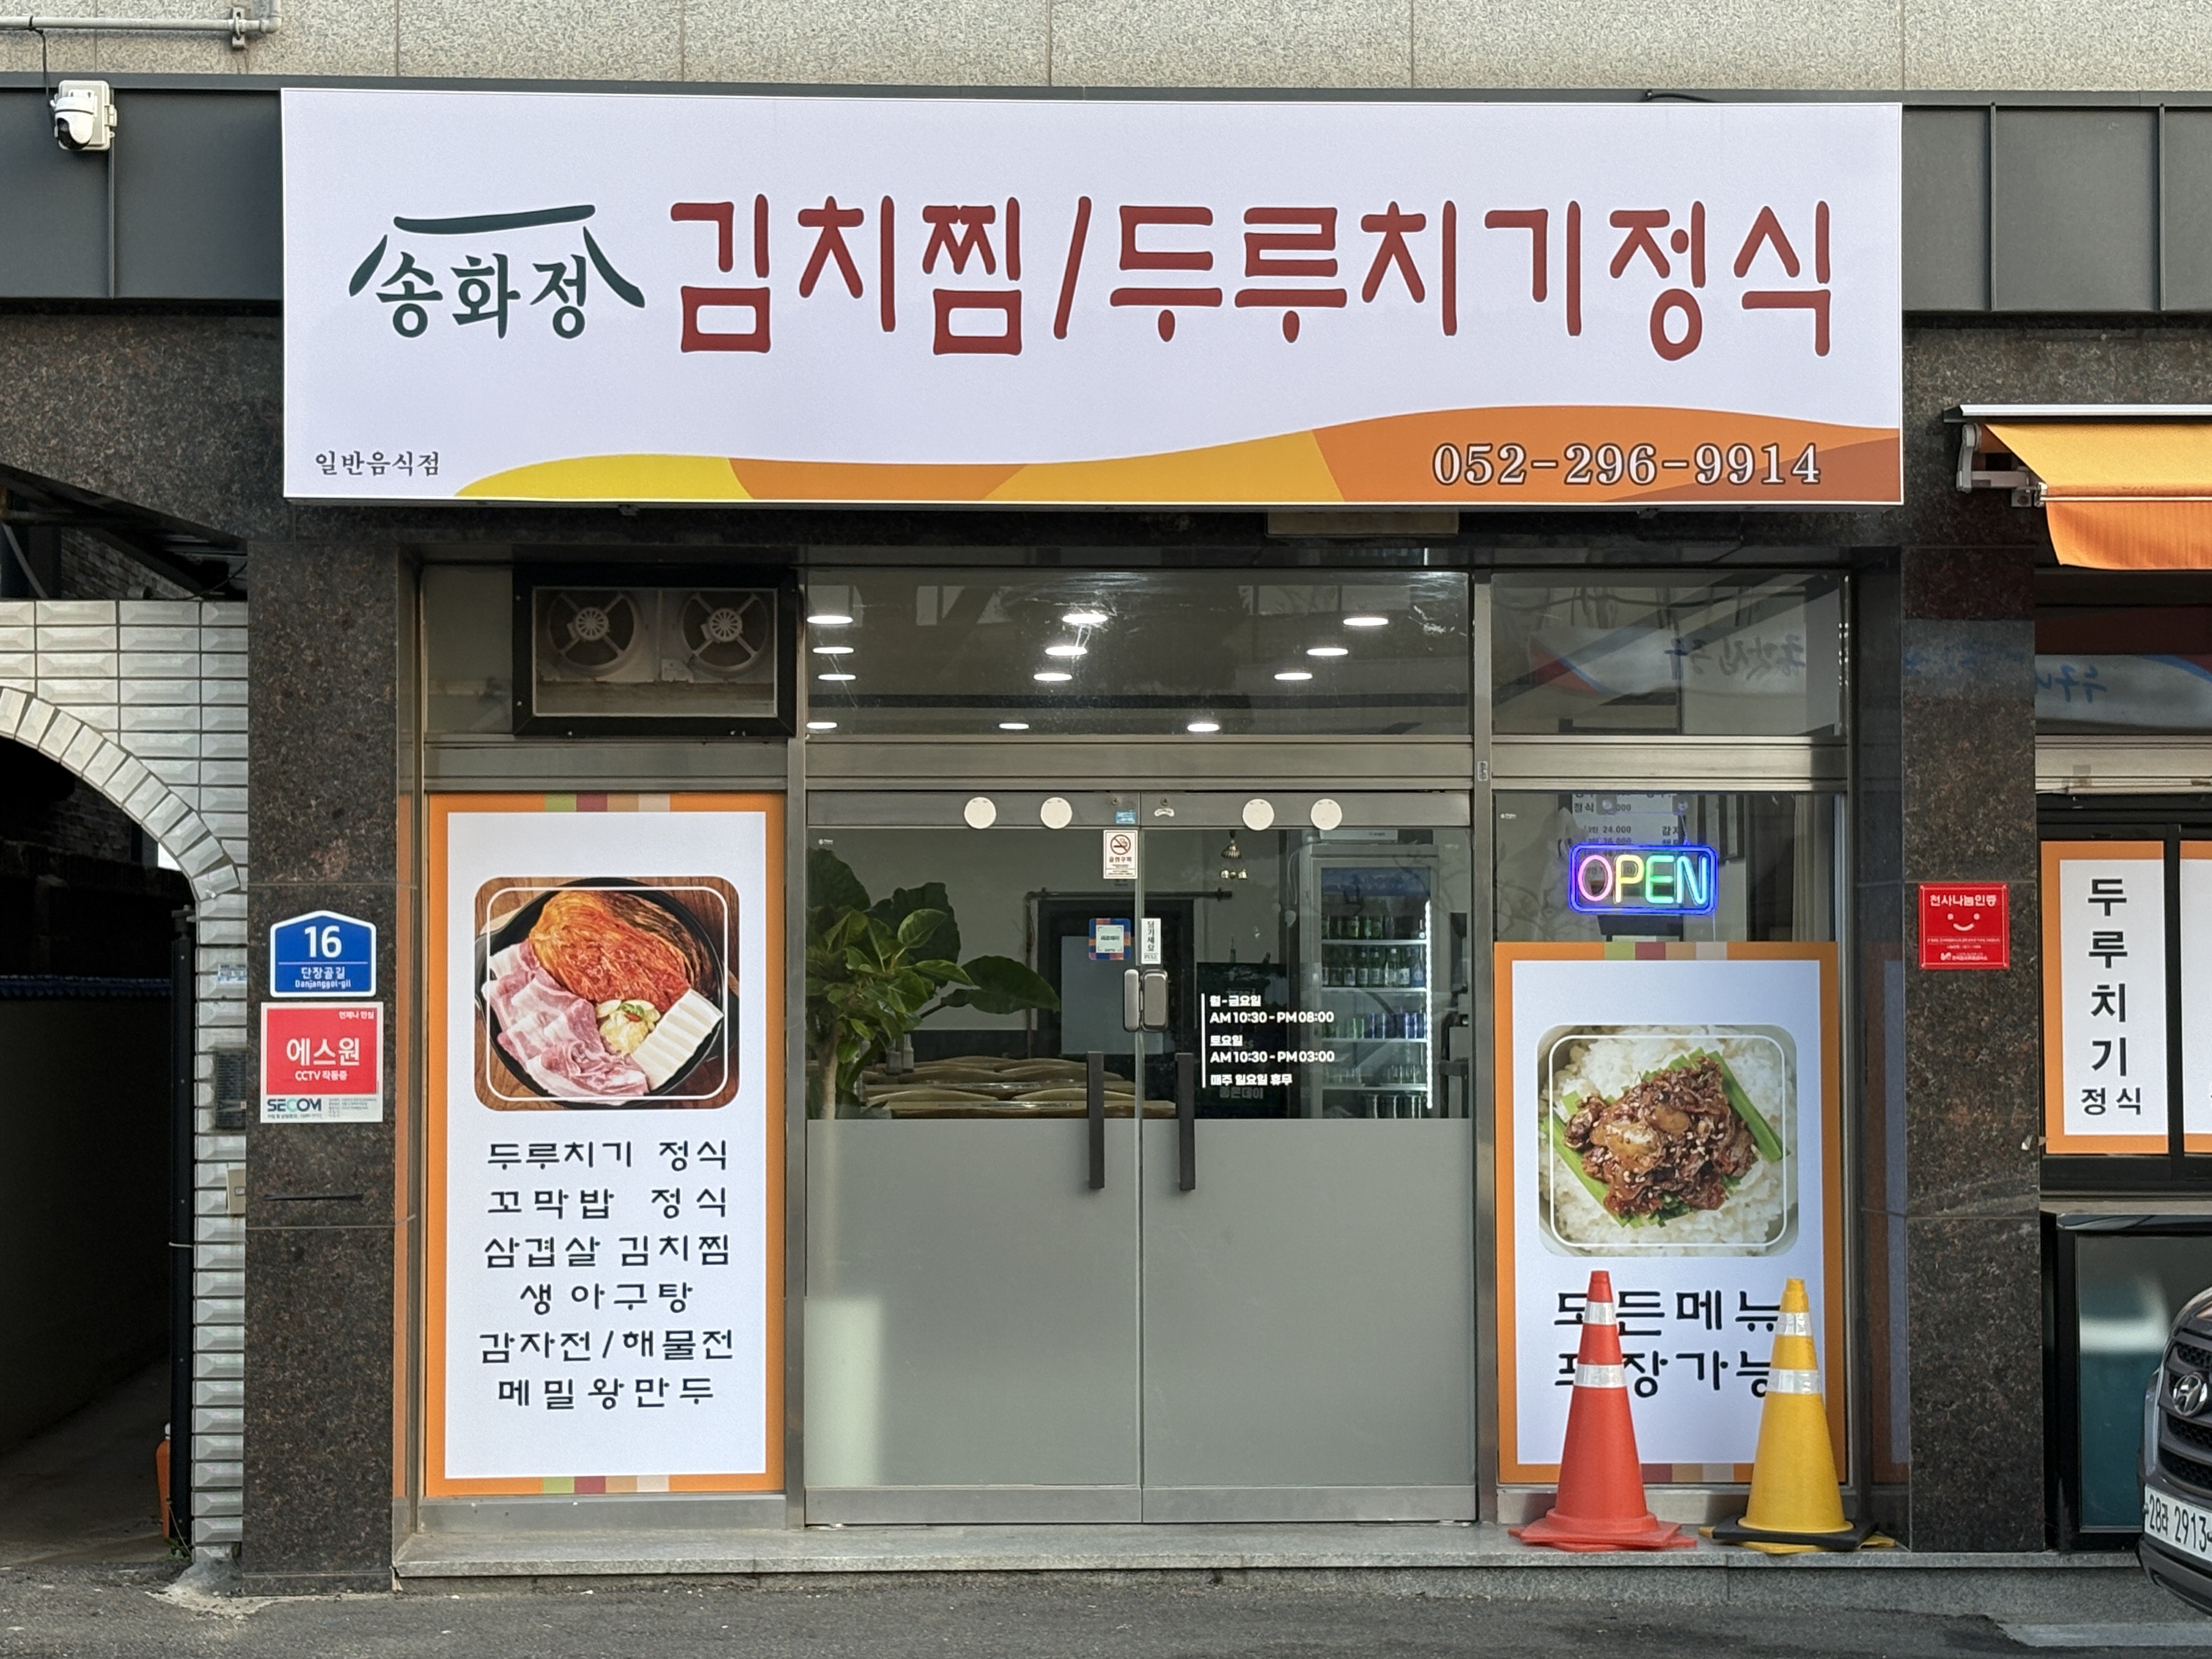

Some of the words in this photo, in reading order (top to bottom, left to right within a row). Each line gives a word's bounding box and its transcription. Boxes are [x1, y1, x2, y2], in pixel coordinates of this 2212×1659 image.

[376, 251, 586, 339] 송화정
[315, 450, 439, 477] 일반음식점
[1432, 443, 1821, 485] 052-296-9914
[1577, 854, 1707, 905] OPEN
[304, 926, 342, 958] 16
[301, 967, 345, 979] 단장골길
[2088, 879, 2128, 1076] 두루치기
[1210, 1012, 1231, 1023] AM
[1233, 1012, 1267, 1023] 10:30
[1277, 1012, 1297, 1023] PM
[1299, 1012, 1334, 1023] 08:00
[286, 1037, 359, 1066] 에스원
[1210, 1035, 1243, 1047] 토요일
[1210, 1052, 1232, 1063] AM
[1233, 1051, 1268, 1063] 10:30
[1277, 1051, 1297, 1063] PM
[1299, 1051, 1335, 1063] 03:00
[295, 1070, 321, 1081] CCTV
[1210, 1074, 1233, 1086] 매주
[1235, 1074, 1268, 1086] 일요일
[1270, 1074, 1293, 1086] 휴무
[267, 1098, 321, 1112] SECOM
[2081, 1087, 2141, 1115] 정식
[487, 1141, 631, 1170] 두루치기
[659, 1140, 726, 1172] 정식
[487, 1188, 614, 1220] 꼬막밥
[651, 1187, 726, 1219] 정식
[484, 1236, 601, 1268] 삼겹살
[618, 1234, 729, 1267] 김치찜
[520, 1283, 551, 1316] 생
[571, 1282, 693, 1313] 아구탕
[2149, 1494, 2169, 1536] 28라
[2175, 1505, 2207, 1553] 2913
